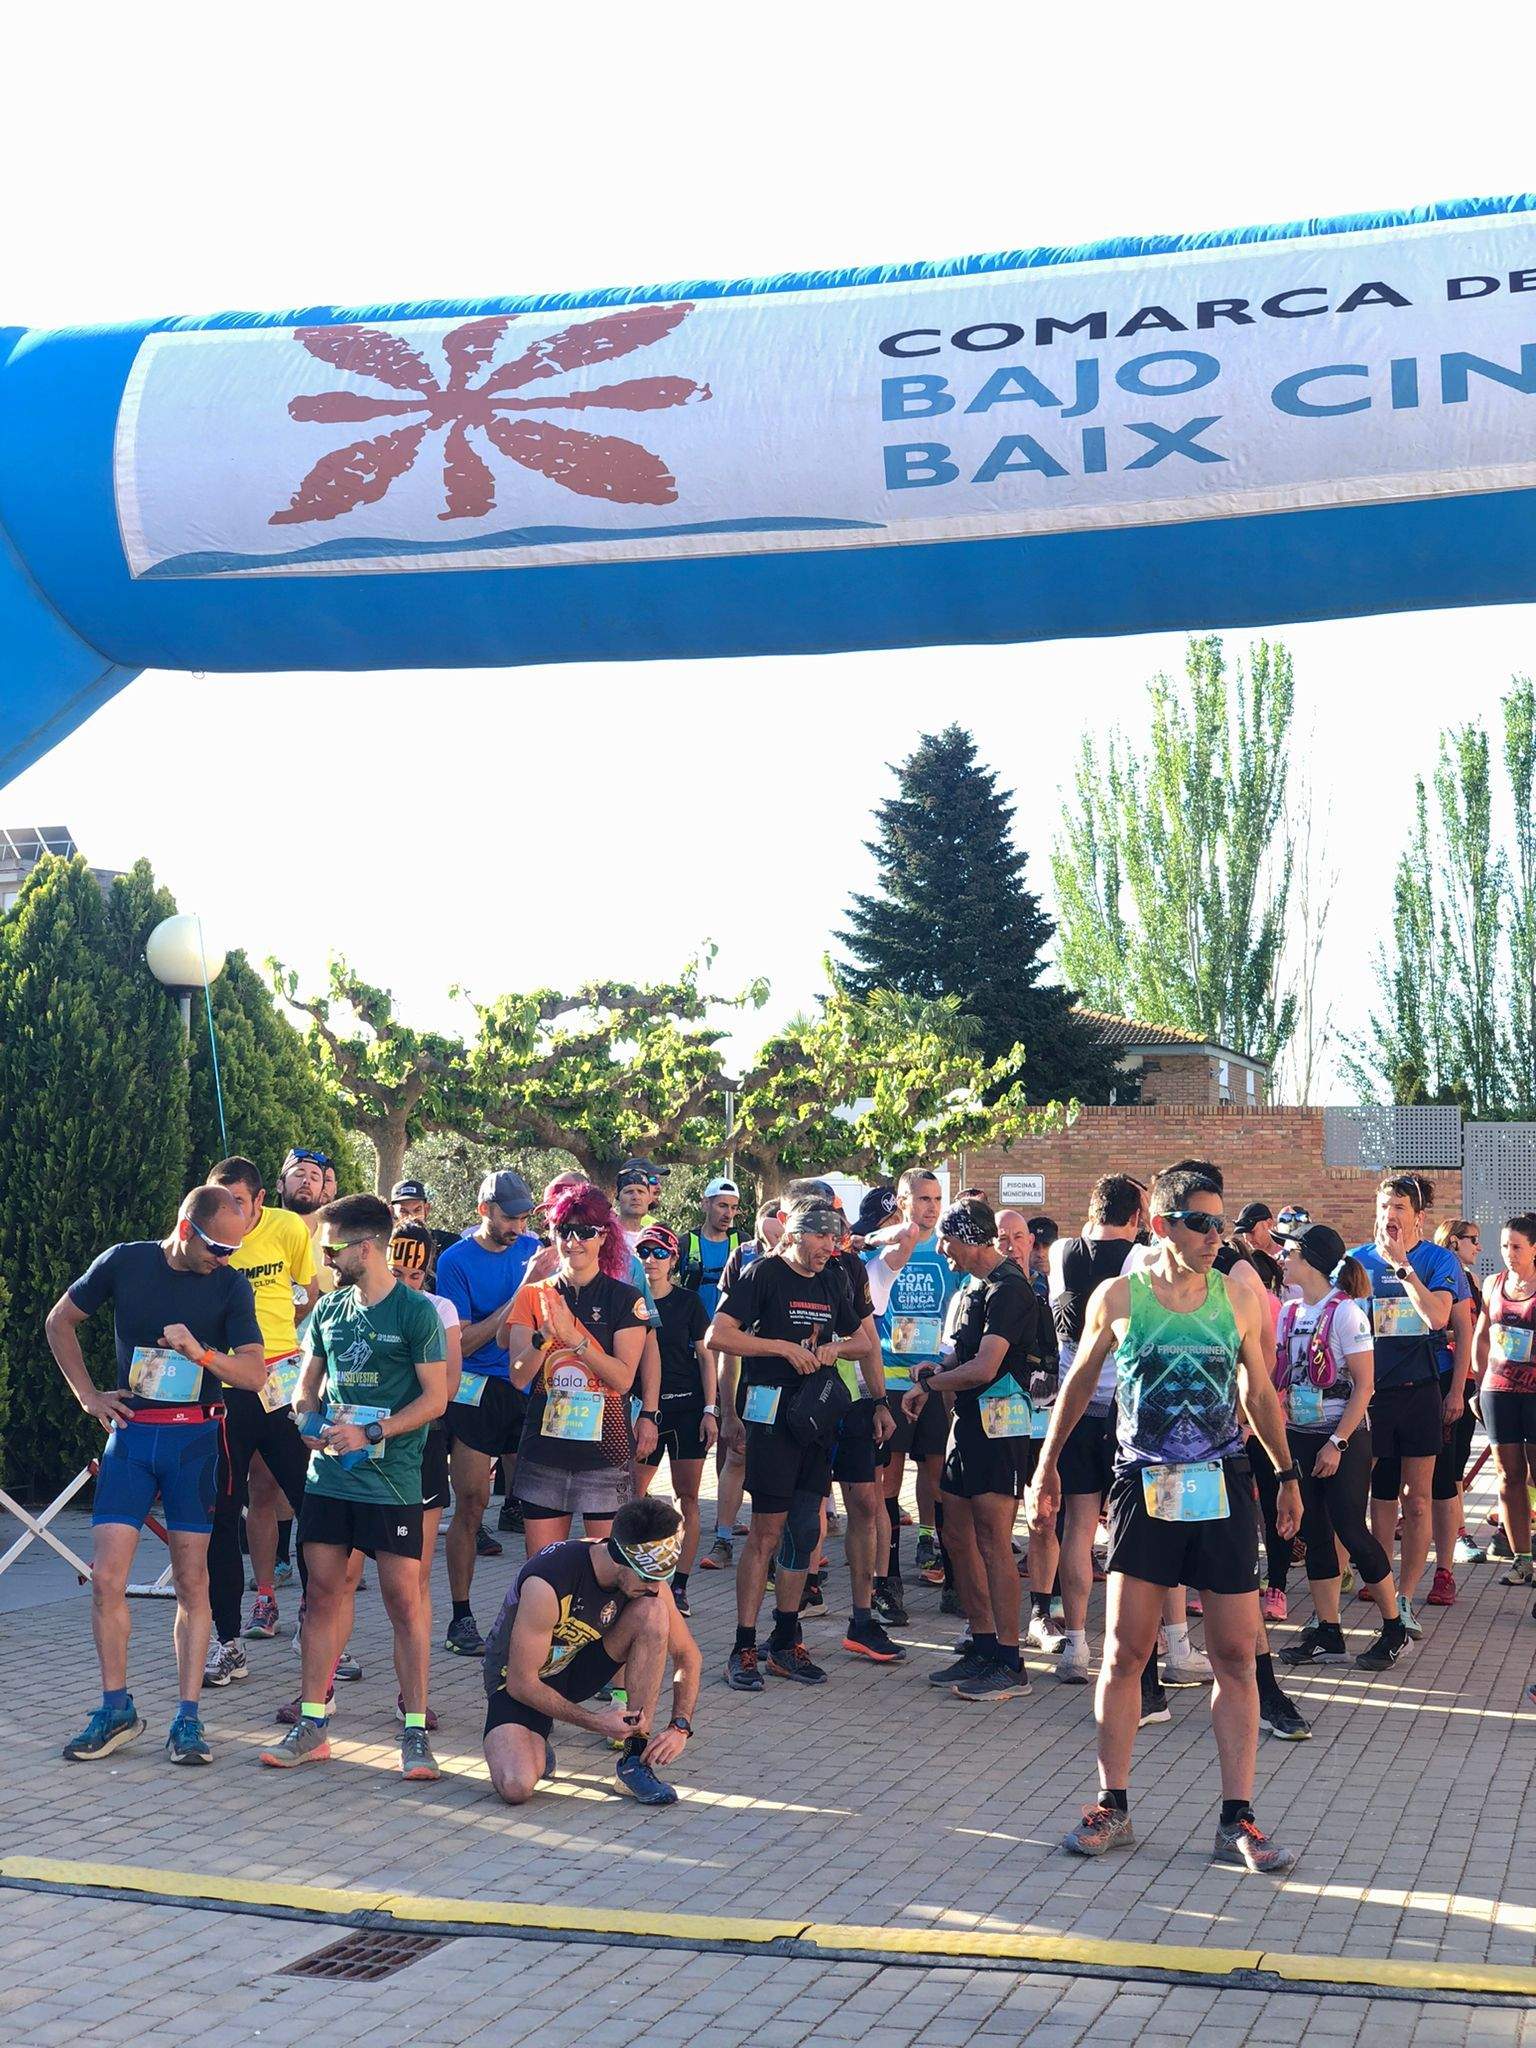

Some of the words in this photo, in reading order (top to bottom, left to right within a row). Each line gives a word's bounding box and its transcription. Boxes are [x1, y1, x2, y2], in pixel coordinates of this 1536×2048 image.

[879, 281, 1413, 358] COMARCA
[881, 349, 1221, 422] BAJO
[883, 415, 1231, 490] BAIX
[897, 1273, 934, 1283] COPA
[897, 1282, 935, 1291] TRAIL
[897, 1295, 935, 1303] CINCA
[1158, 1345, 1226, 1355] FRONTRUNNER
[1175, 1480, 1197, 1494] 35
